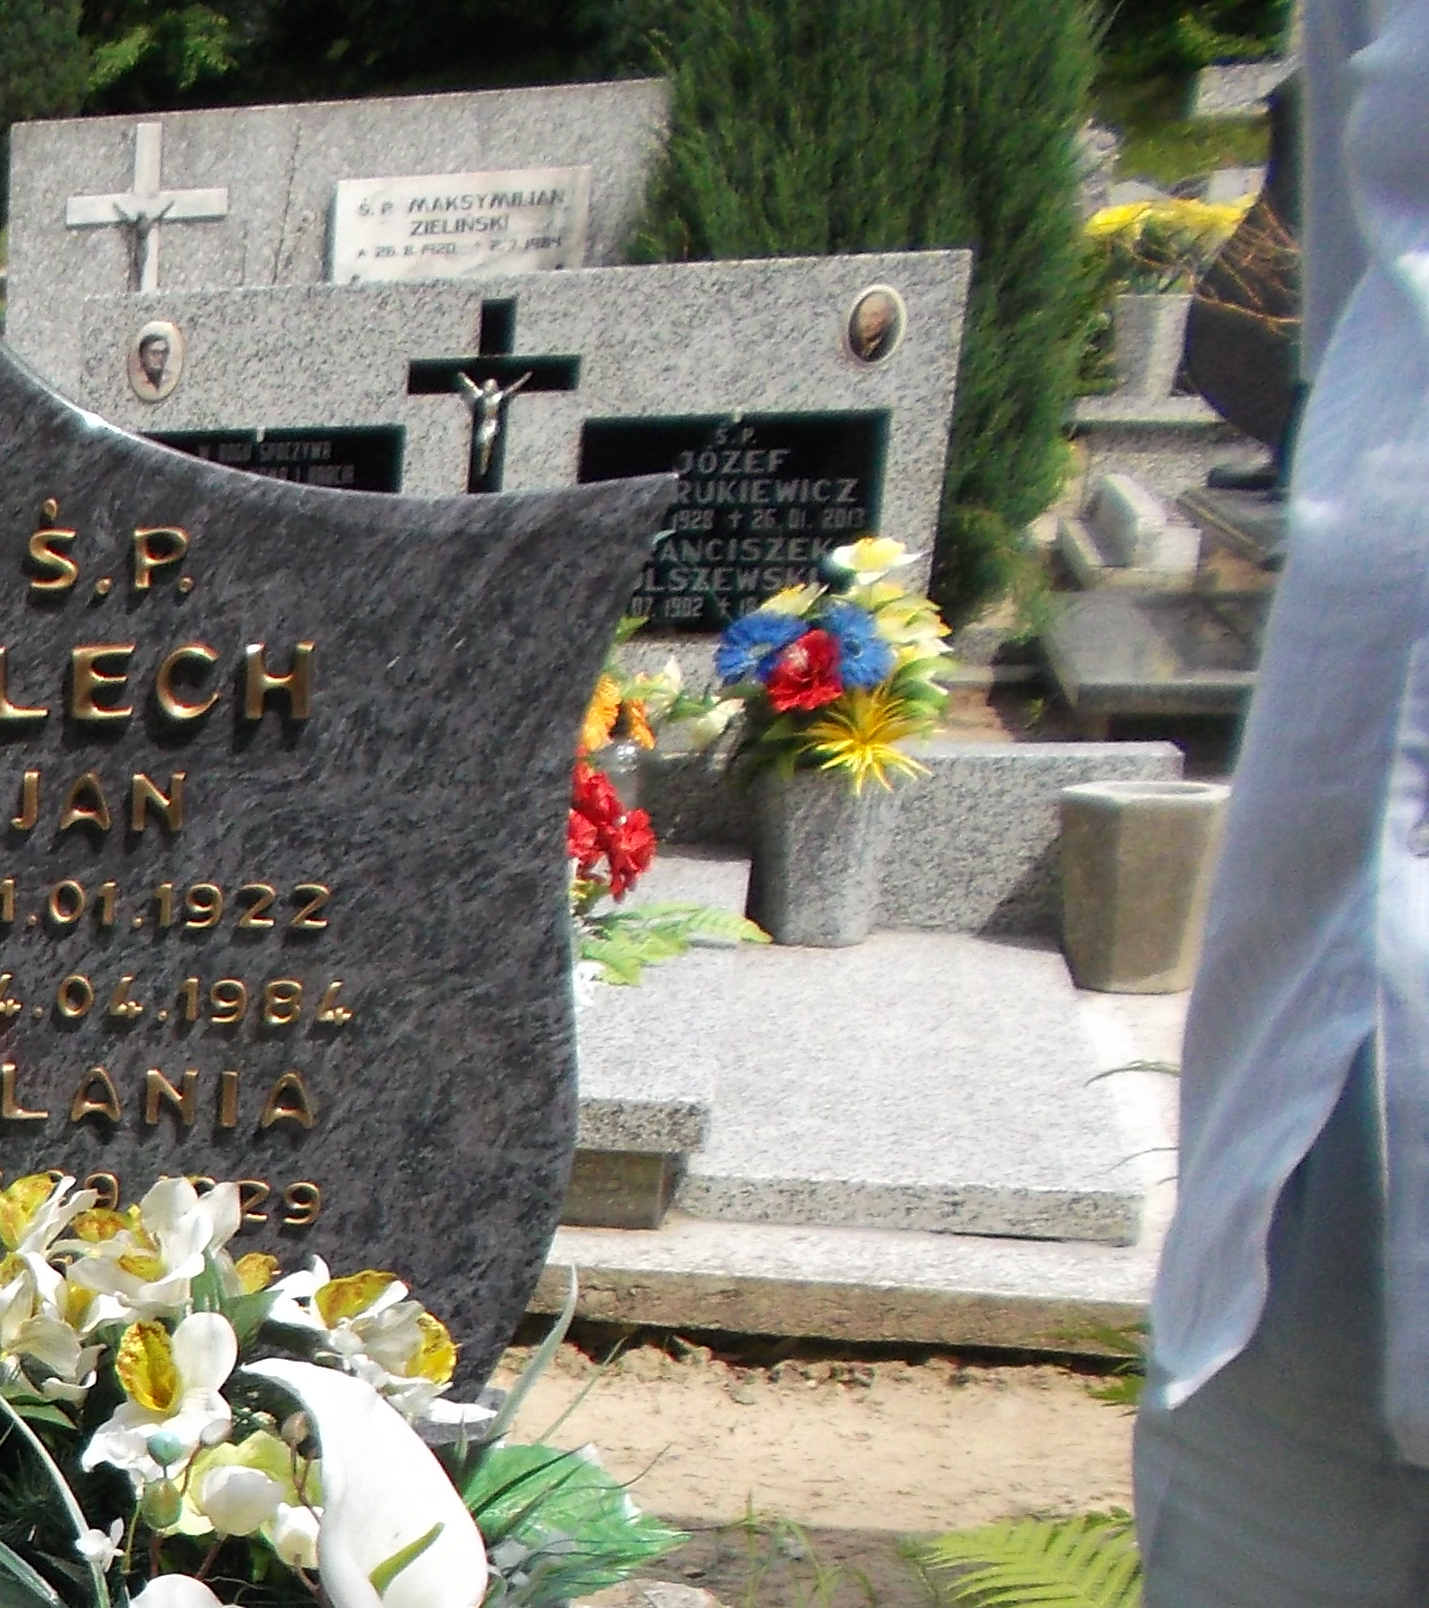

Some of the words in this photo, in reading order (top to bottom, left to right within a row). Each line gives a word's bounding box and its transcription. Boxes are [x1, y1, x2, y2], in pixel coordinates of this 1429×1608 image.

[408, 188, 567, 215] MAKSYMILIAN
[409, 215, 510, 237] ZIELIŃSKI
[675, 444, 791, 475] JÓZEF
[658, 537, 832, 563] ANCISZEK
[637, 566, 821, 593] LSZEWSKI
[8, 771, 188, 834] JAN
